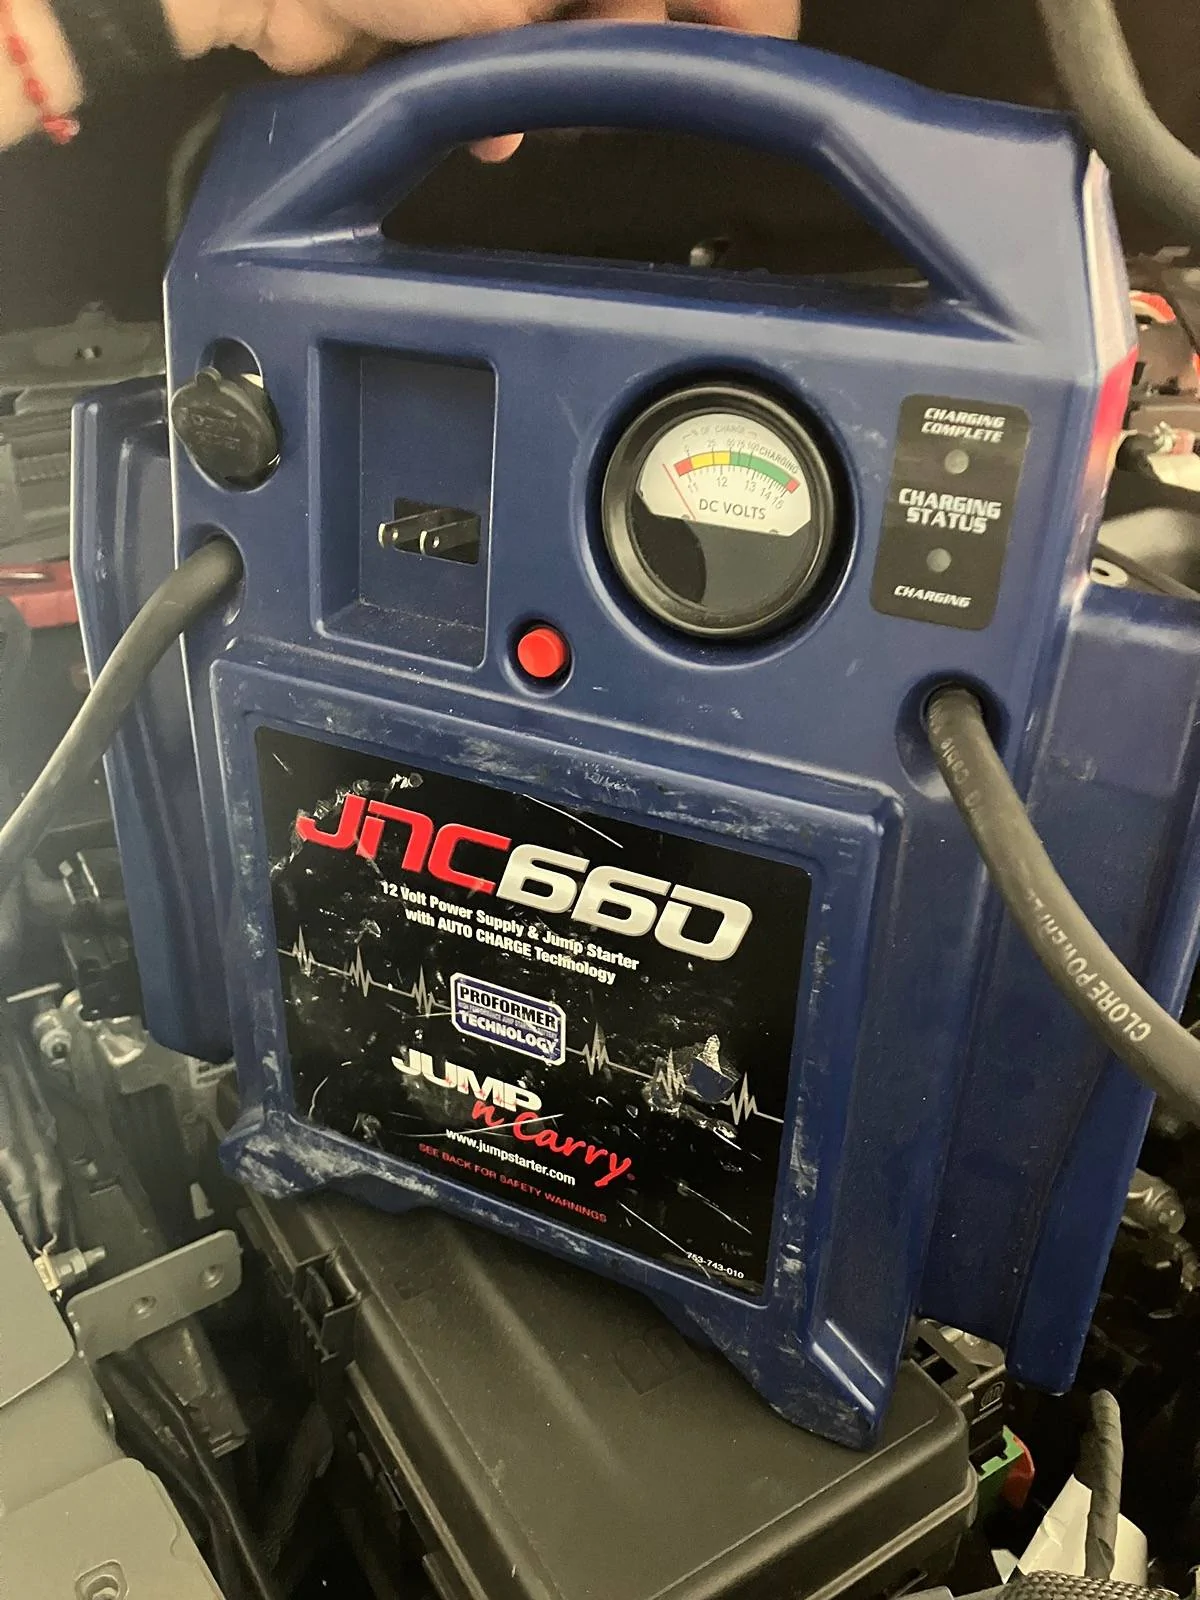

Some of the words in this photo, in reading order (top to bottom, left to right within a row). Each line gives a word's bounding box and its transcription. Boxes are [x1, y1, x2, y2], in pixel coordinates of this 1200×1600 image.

[921, 421, 1004, 443] COMPLETE
[924, 407, 1006, 428] CHARGING
[759, 446, 799, 474] CHARGING
[699, 498, 719, 513] DC
[723, 501, 766, 520] VOLTS
[716, 476, 728, 488] 12
[744, 480, 756, 493] 13
[760, 487, 771, 501] 14
[898, 487, 1002, 520] CHARGING
[906, 507, 988, 534] STATUS
[894, 585, 972, 608] CHARGING
[380, 880, 399, 898] 12
[400, 886, 427, 906] Volt
[429, 895, 473, 919] Power
[475, 909, 524, 938] Supply
[527, 925, 540, 940] &
[542, 930, 584, 955] Jump
[586, 942, 640, 970] Starter
[405, 908, 435, 927] with
[437, 917, 473, 938] AUTO
[475, 928, 532, 957] CHARGE
[534, 946, 616, 985] Technology
[459, 985, 556, 1030] PROFORMER
[1086, 980, 1152, 1042] CLORE
[460, 1010, 559, 1055] TECHNOLOGY
[391, 1048, 542, 1112] JUMP
[446, 1128, 575, 1186] www.jumpstarter.com
[513, 1111, 632, 1188] Carry
[418, 1143, 439, 1157] SEE
[442, 1151, 472, 1170] BACK
[474, 1164, 497, 1179] FOR
[499, 1174, 541, 1196] SAFETY
[544, 1192, 607, 1223] WARNINGS
